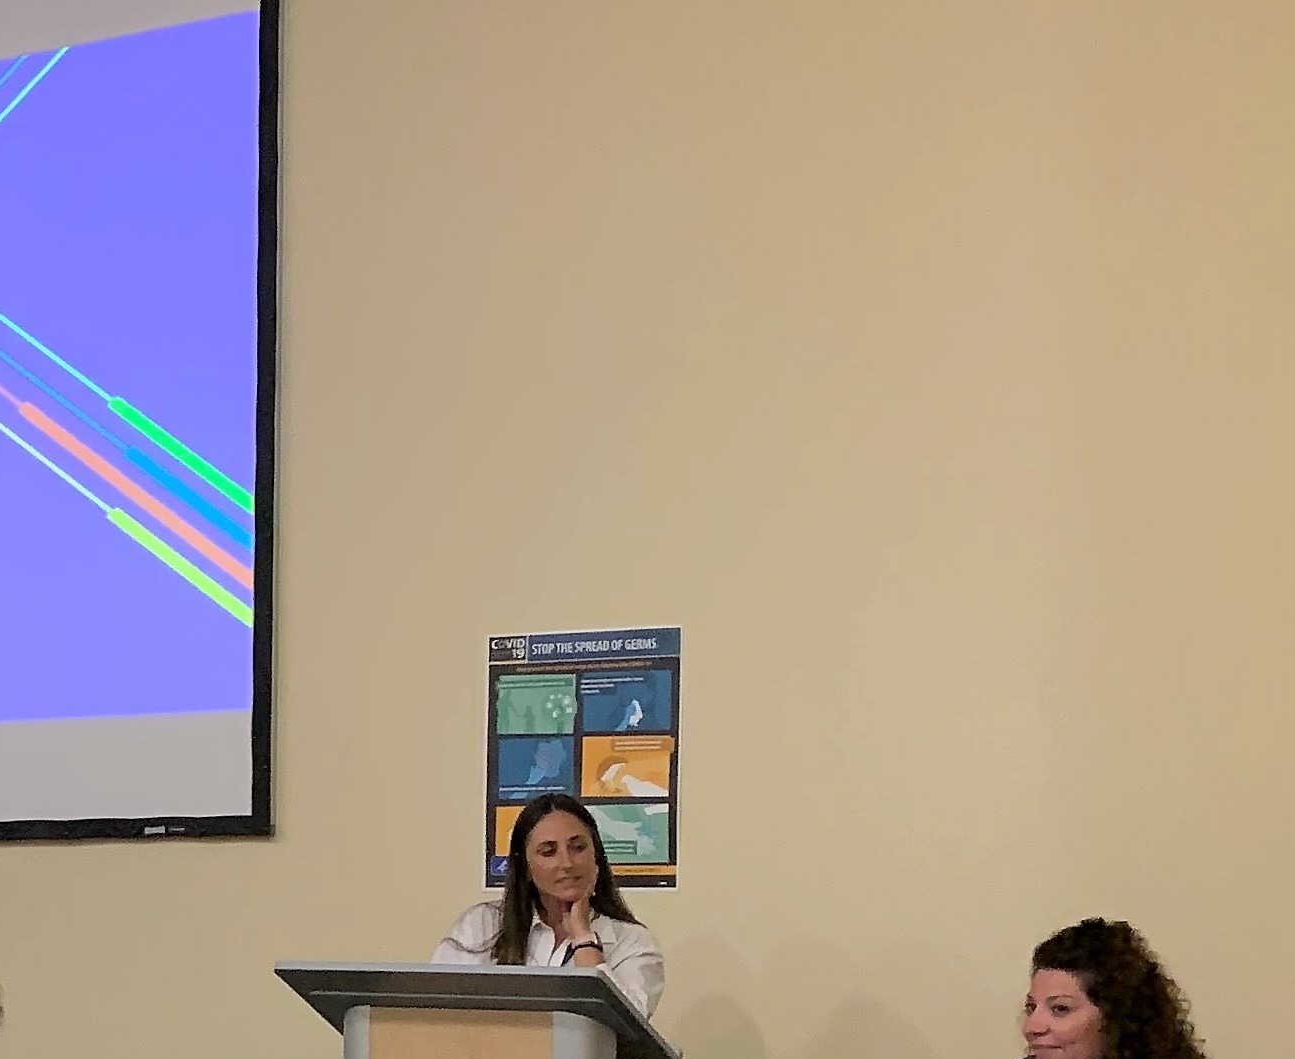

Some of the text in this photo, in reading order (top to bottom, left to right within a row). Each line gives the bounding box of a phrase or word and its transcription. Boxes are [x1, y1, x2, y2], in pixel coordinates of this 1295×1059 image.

[511, 648, 526, 660] 19
[531, 637, 657, 656] STOP THE SPREAD OF GERMS
